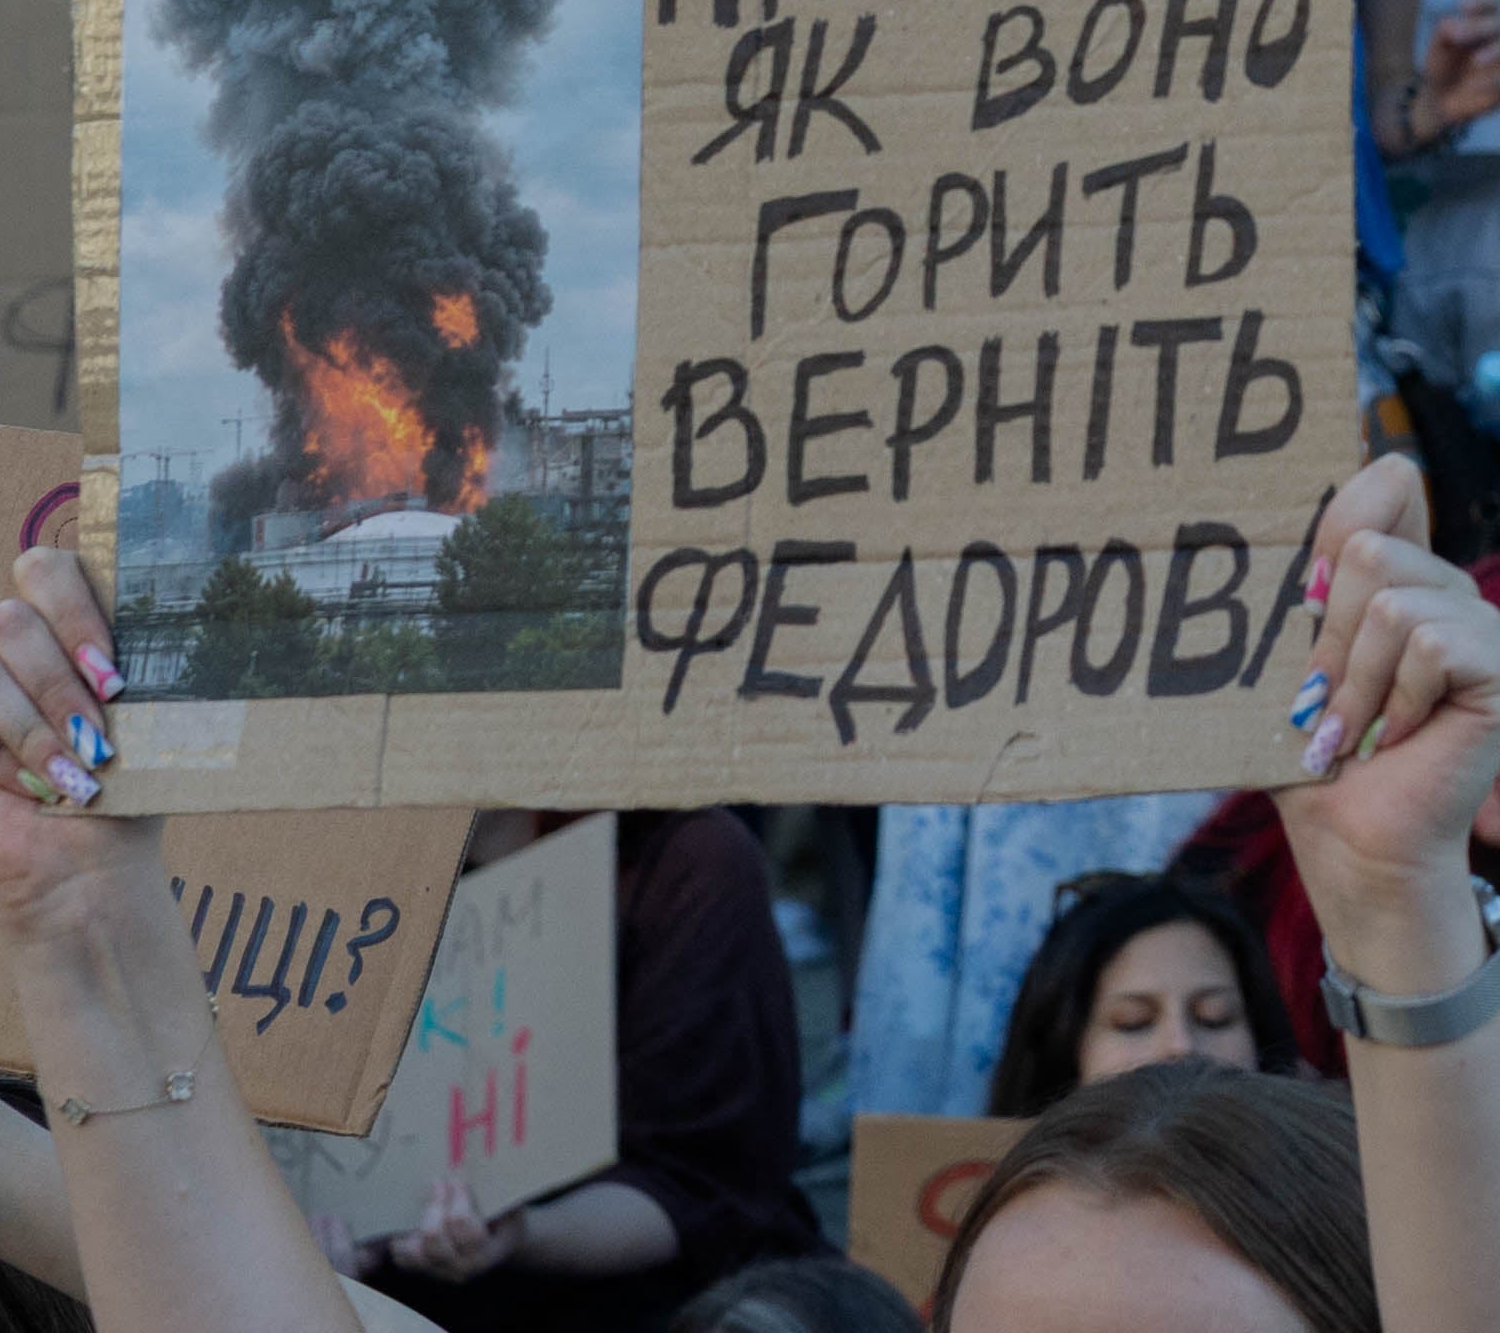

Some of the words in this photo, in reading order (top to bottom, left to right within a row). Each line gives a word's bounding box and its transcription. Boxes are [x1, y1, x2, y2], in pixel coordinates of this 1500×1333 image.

[690, 12, 884, 167] ЯК
[749, 137, 1260, 343] ГОРИТЬ
[661, 308, 1306, 509] ВЕРНІТЬ
[417, 967, 509, 1053] К!
[447, 1023, 534, 1171] НІ
